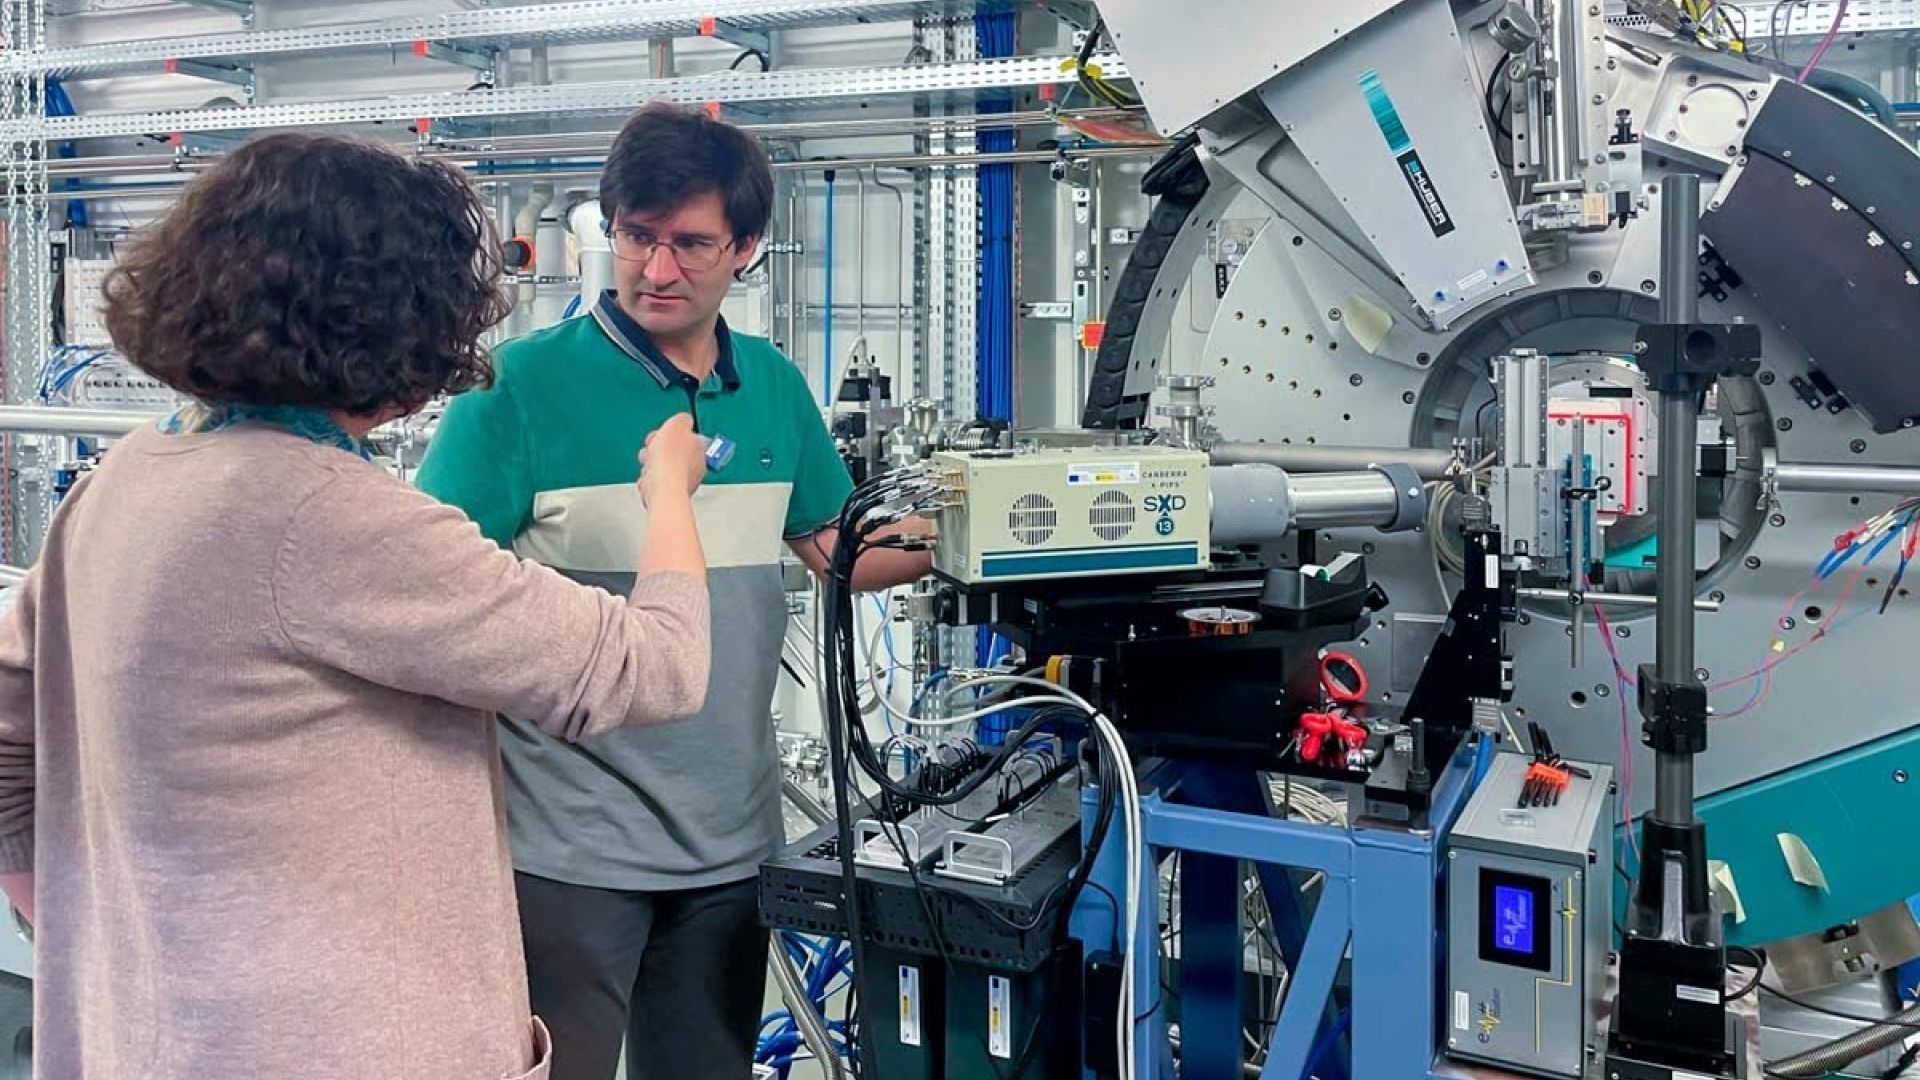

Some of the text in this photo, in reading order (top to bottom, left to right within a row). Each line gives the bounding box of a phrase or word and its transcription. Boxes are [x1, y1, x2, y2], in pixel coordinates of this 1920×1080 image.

[1413, 171, 1446, 224] HUBER
[1143, 494, 1187, 512] SXD
[1158, 520, 1172, 532] 13
